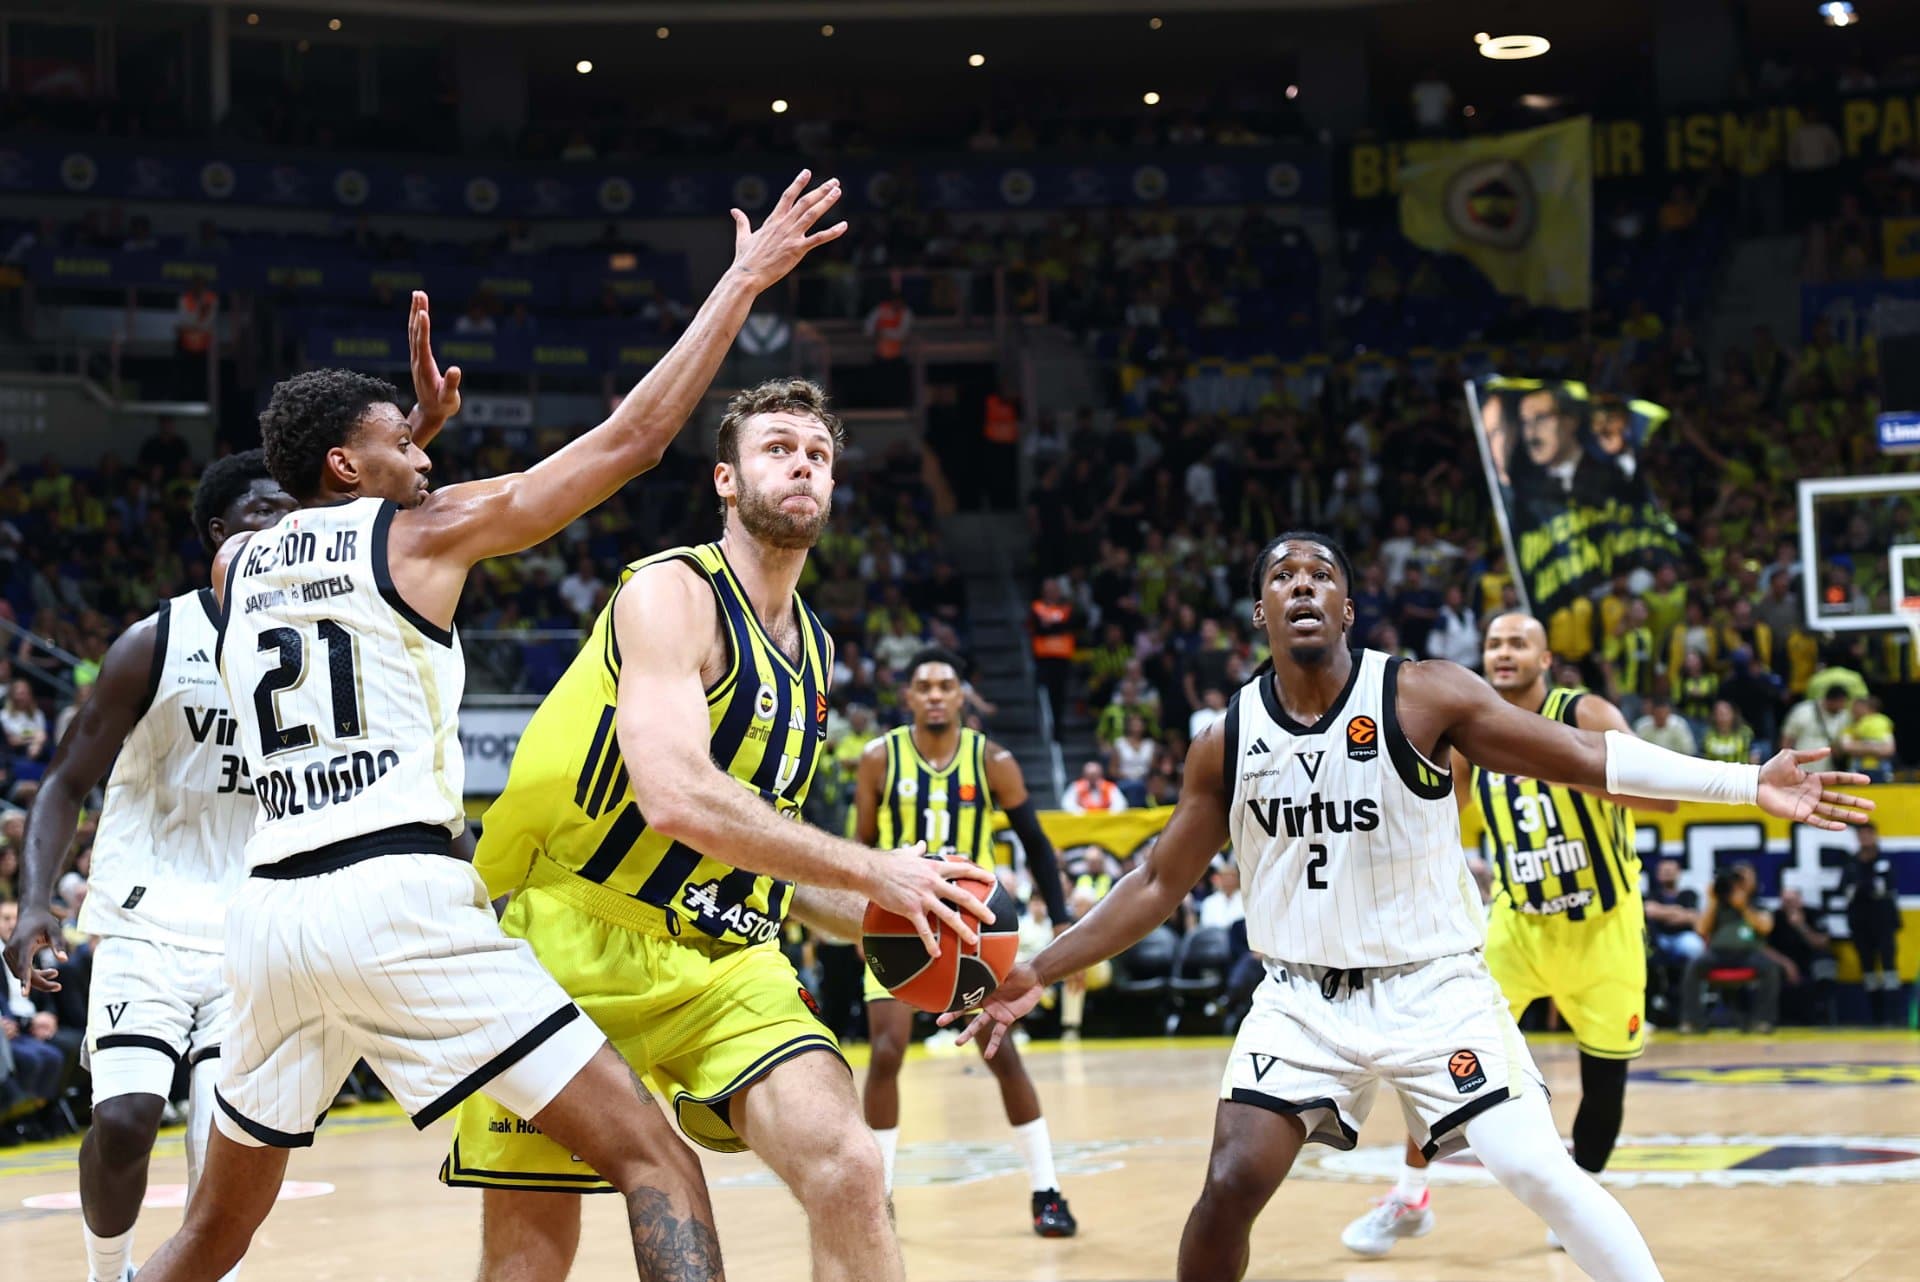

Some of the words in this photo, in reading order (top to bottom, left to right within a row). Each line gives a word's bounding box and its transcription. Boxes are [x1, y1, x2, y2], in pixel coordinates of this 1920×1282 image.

[1841, 96, 1920, 158] PA
[326, 530, 357, 562] JR
[301, 574, 355, 603] HOTELS
[254, 618, 369, 758] 21
[1249, 768, 1281, 780] Pelliconi
[923, 808, 951, 842] 11
[1247, 792, 1380, 838] Virtus
[1514, 793, 1557, 833] 31
[1307, 844, 1328, 889] 2
[1506, 834, 1589, 884] tarfin
